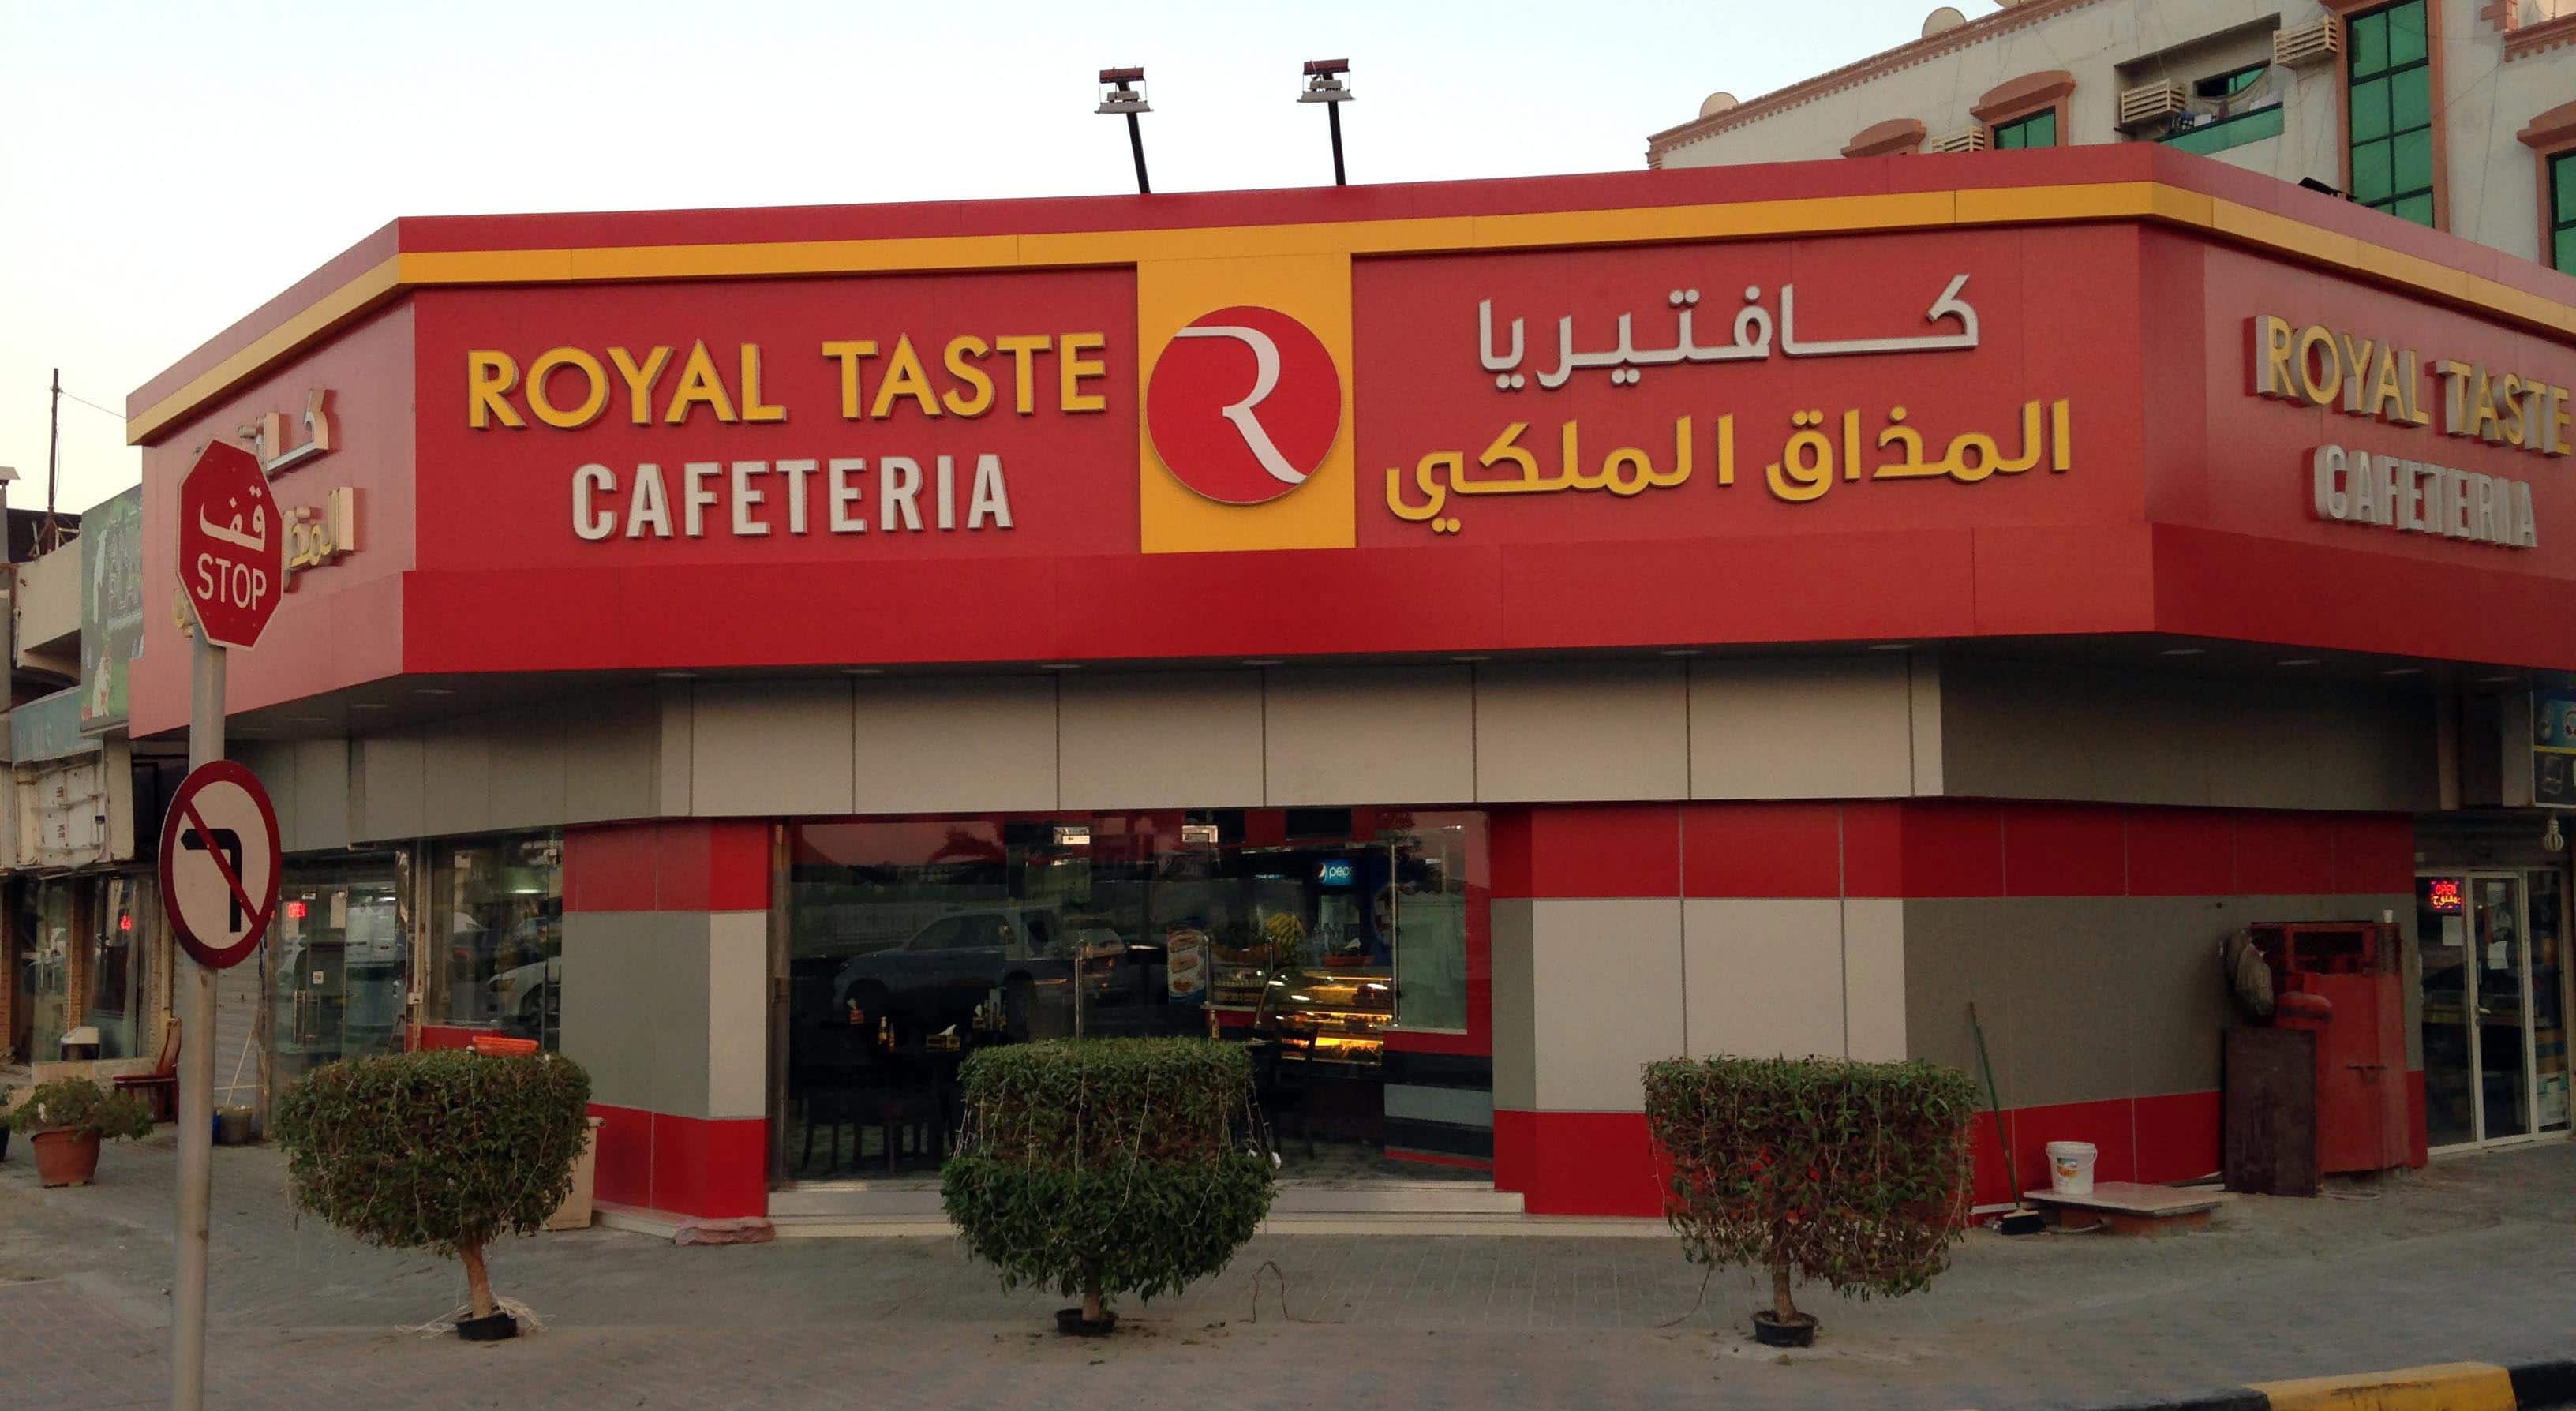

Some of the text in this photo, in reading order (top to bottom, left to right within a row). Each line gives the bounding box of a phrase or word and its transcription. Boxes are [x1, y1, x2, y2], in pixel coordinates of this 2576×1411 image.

[468, 332, 1106, 429] ROYAL TASTE
[1478, 274, 1979, 391] كافتيريا
[1174, 325, 1308, 484] R
[2256, 315, 2571, 455] ROYAL TASTE
[571, 453, 1013, 541] CAFETERIA
[1385, 398, 2071, 533] المذاق الملكي
[2314, 444, 2538, 548] CAFETERIA
[200, 485, 266, 552] قف
[197, 552, 267, 611] STOP
[2436, 884, 2456, 895] OPEN
